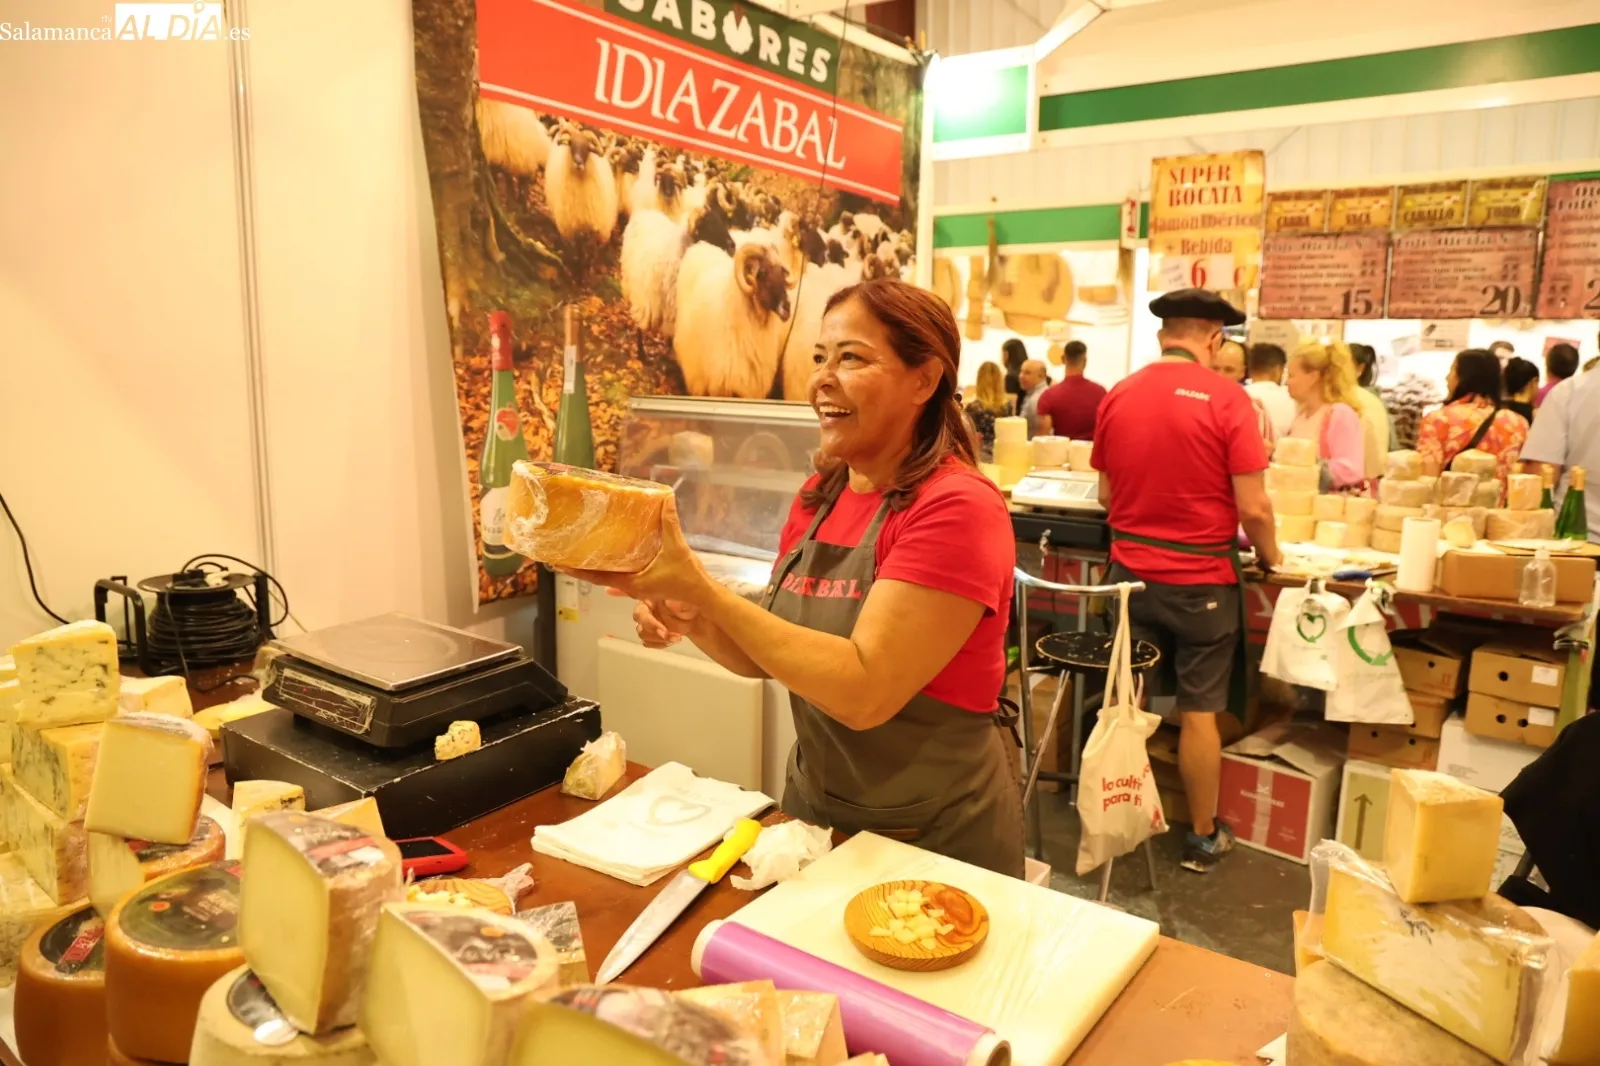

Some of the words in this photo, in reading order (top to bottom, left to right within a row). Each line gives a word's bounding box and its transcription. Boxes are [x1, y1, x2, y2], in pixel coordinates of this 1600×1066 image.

[594, 37, 847, 170] IDIAZABAL
[1169, 164, 1231, 185] SUPER
[1168, 185, 1242, 208] BOCATA
[1181, 236, 1233, 255] Bebida
[1191, 258, 1207, 289] 6
[1341, 289, 1373, 315] 15
[1479, 285, 1521, 315] 20
[1103, 792, 1131, 812] para
